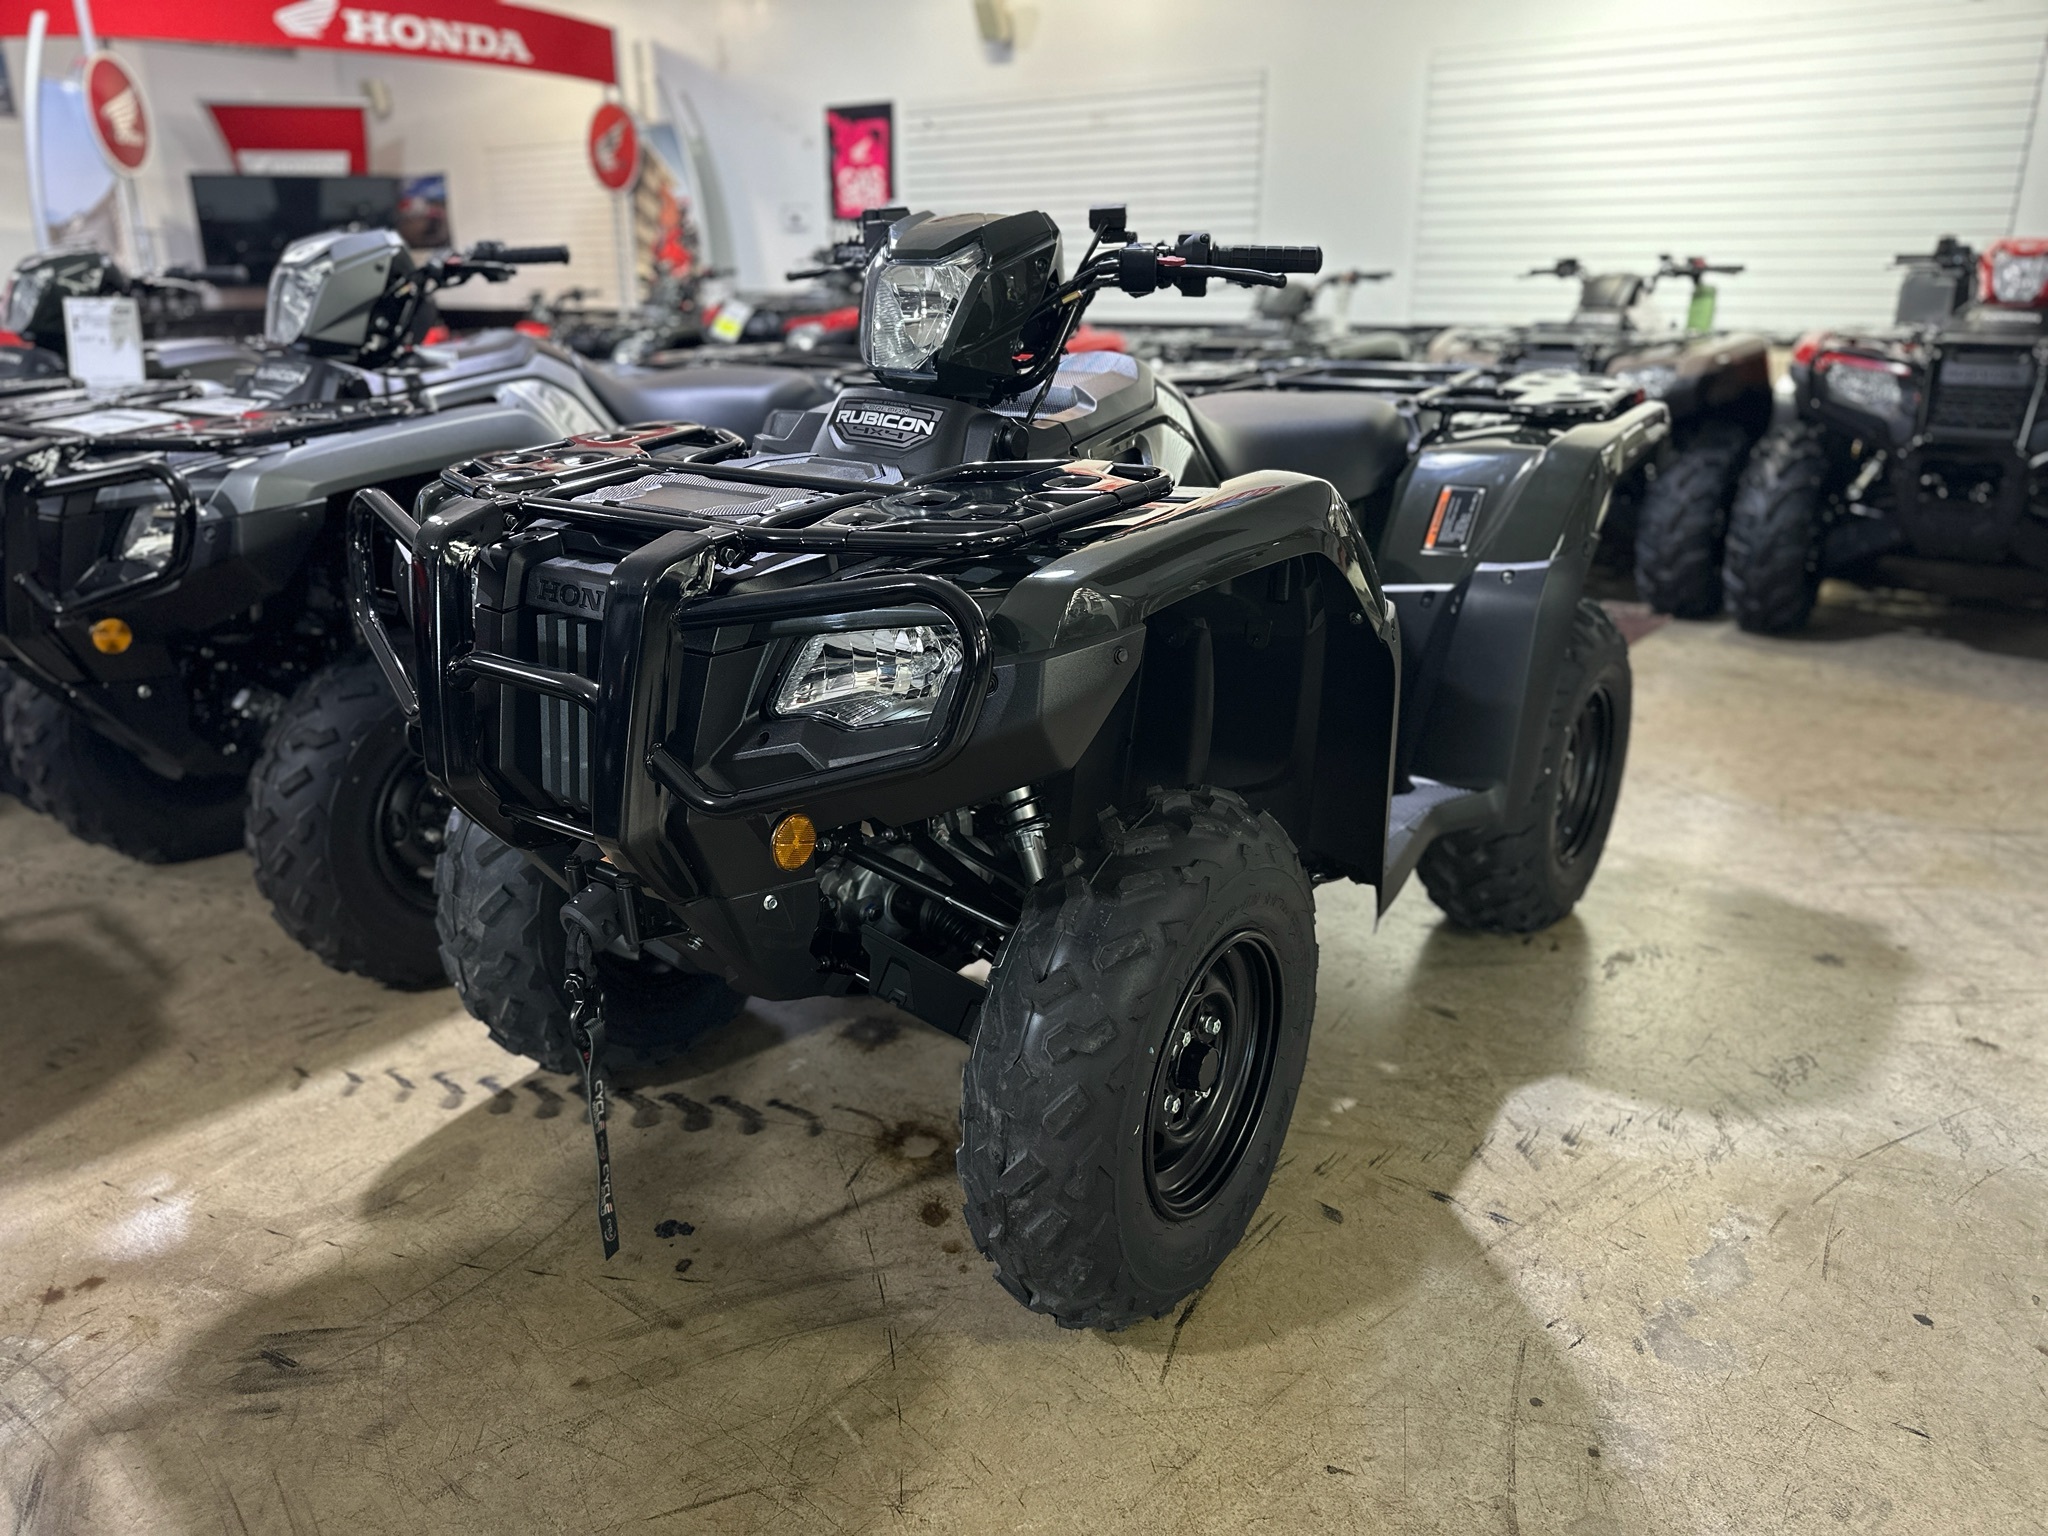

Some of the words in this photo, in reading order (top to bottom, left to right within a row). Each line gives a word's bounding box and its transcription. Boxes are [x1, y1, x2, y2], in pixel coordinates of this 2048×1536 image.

[340, 8, 534, 63] HONDA
[836, 410, 936, 436] RUBICON
[862, 403, 910, 415] FOREMAN
[537, 580, 604, 611] HON
[595, 1080, 606, 1132] CYCLE
[603, 1164, 613, 1213] CYCLE
